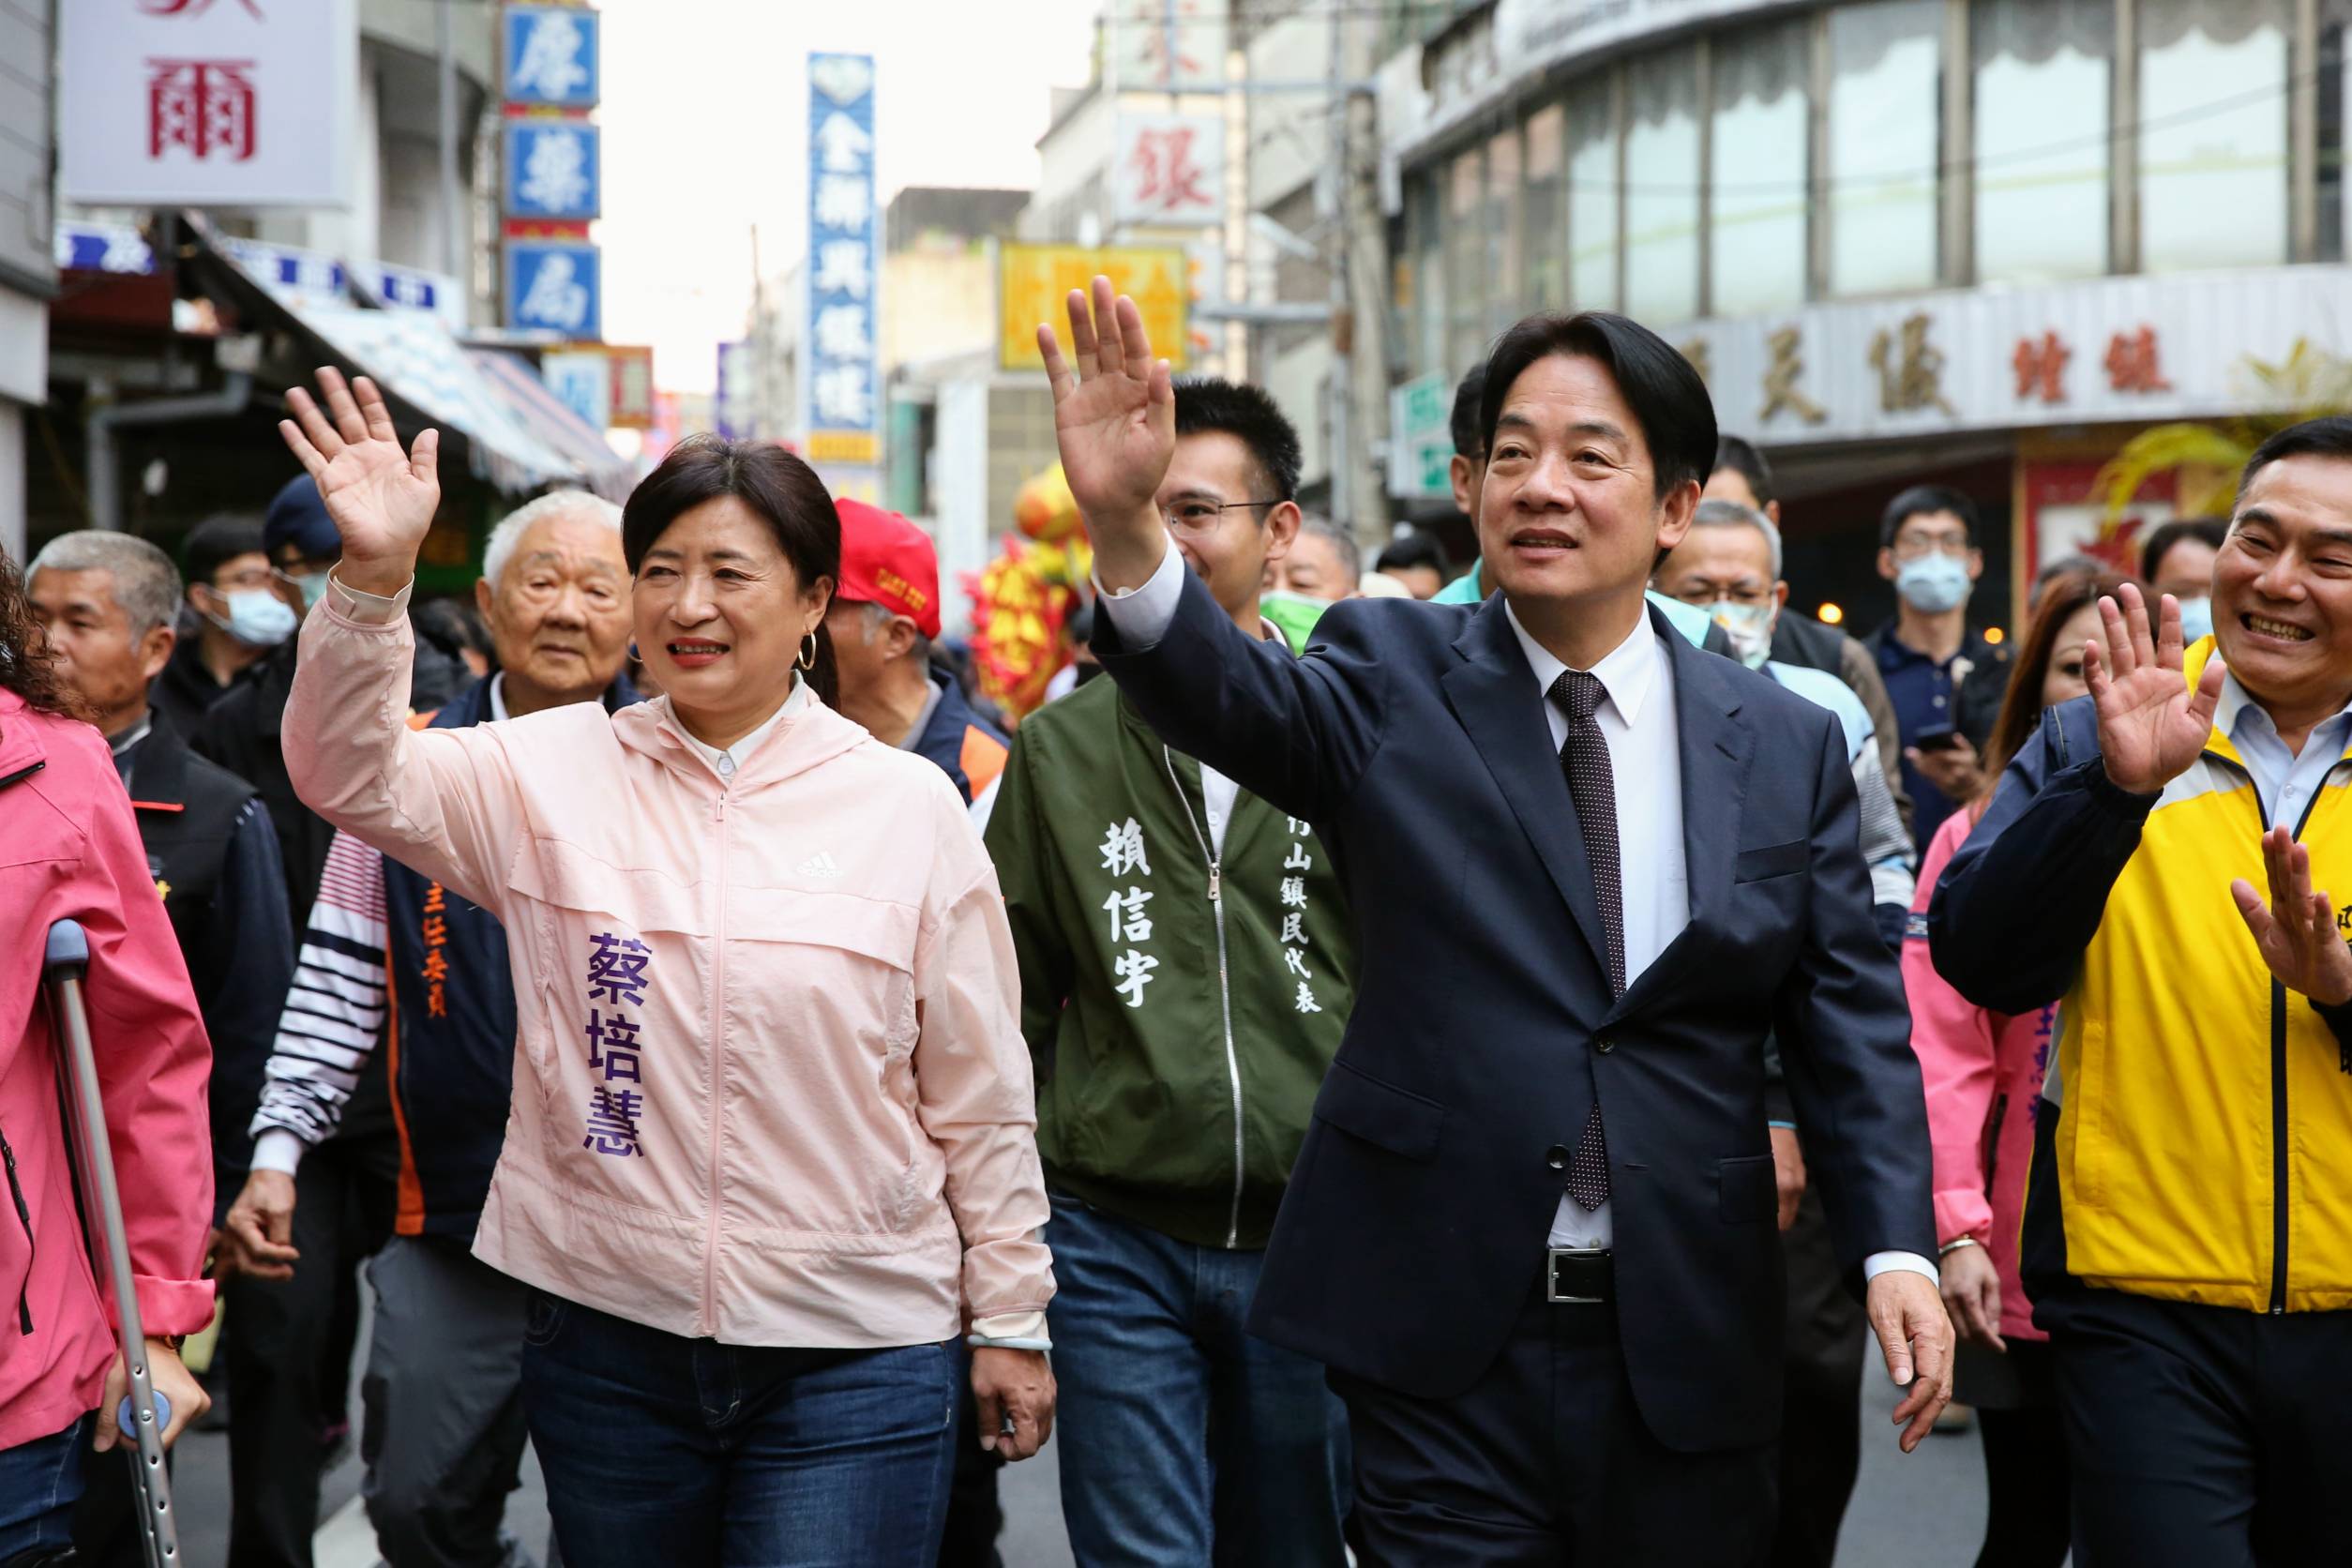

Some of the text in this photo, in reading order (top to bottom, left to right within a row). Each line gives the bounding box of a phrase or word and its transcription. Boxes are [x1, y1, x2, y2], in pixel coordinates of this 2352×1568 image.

[796, 864, 846, 879] adidas
[1098, 817, 1160, 1008] 賴信宇
[583, 932, 653, 1158] 蔡培慧
